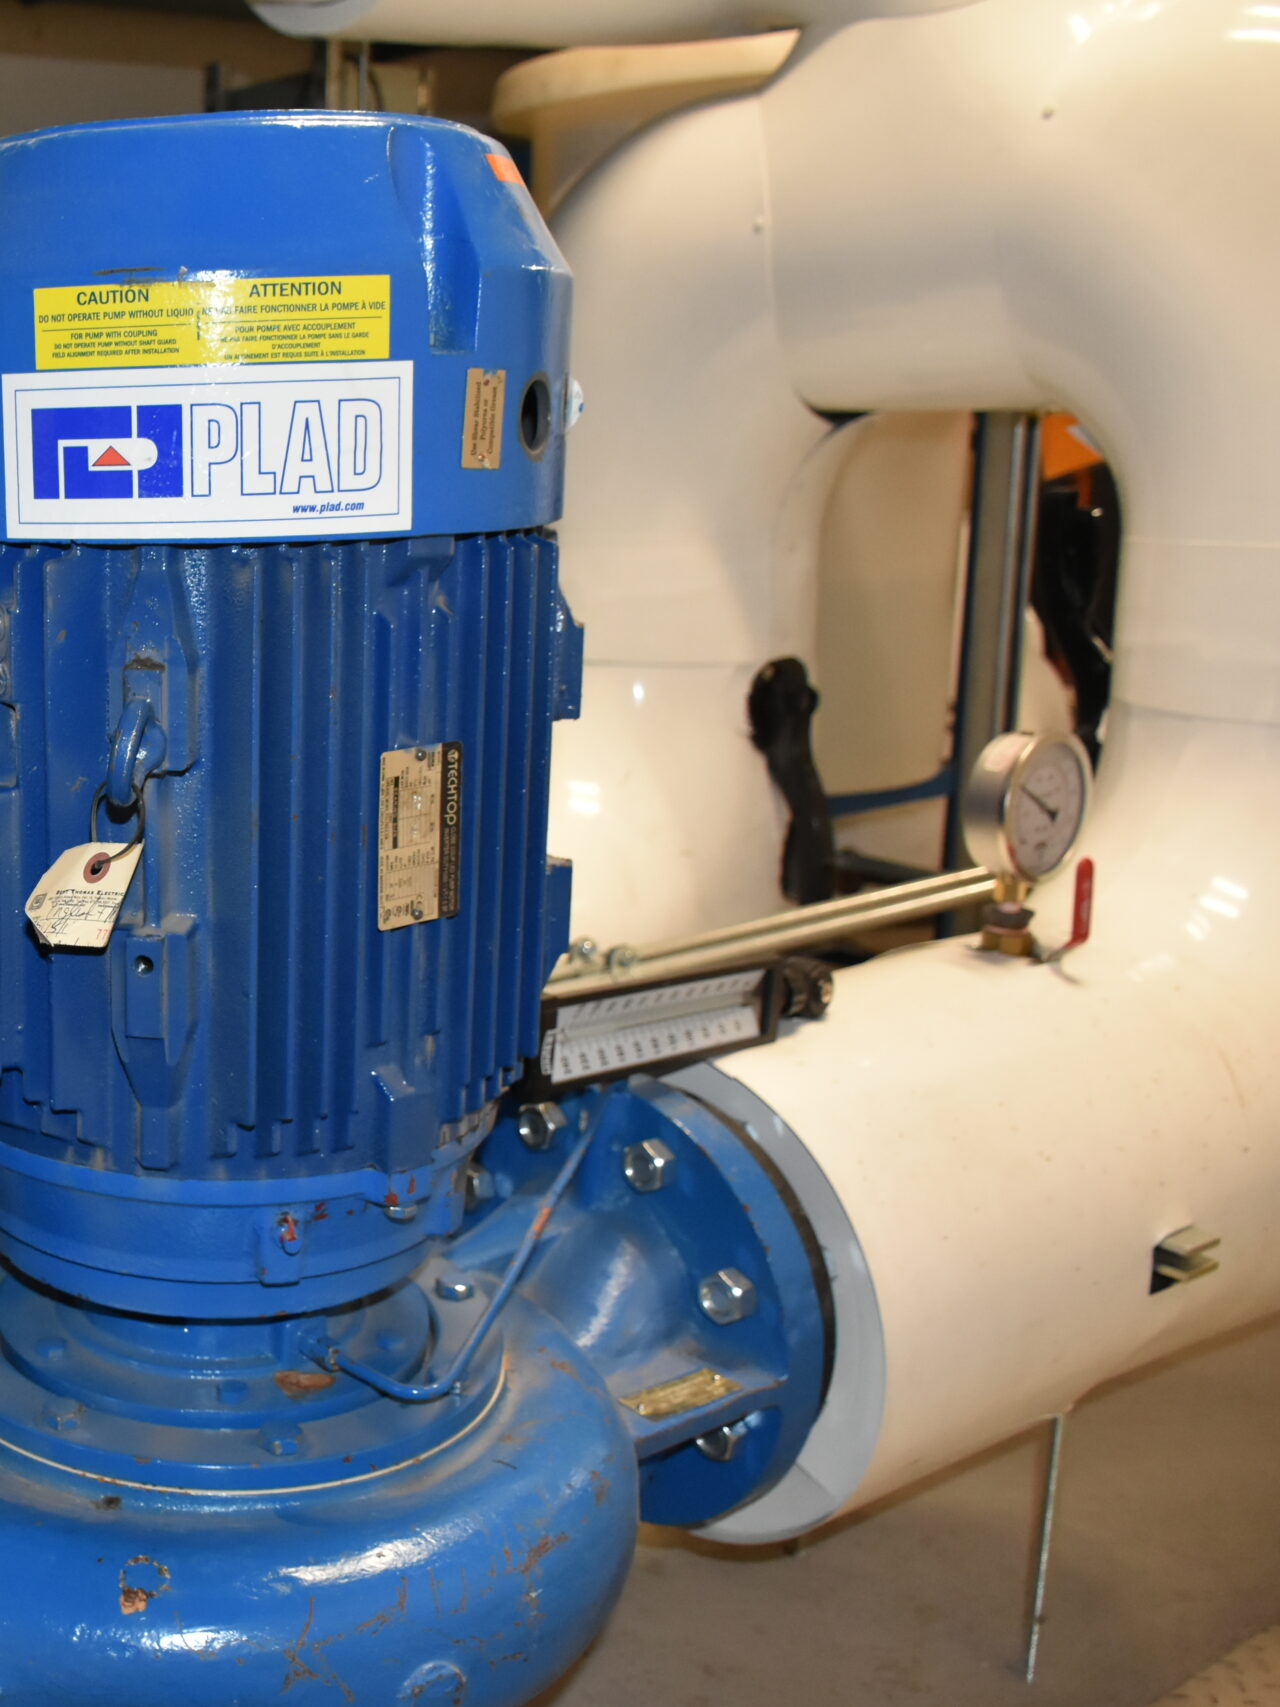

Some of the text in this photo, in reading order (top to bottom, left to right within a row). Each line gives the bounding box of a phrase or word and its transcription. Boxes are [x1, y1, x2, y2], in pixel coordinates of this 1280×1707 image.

[249, 281, 342, 298] ATTENTION
[77, 289, 149, 306] CAUTION
[235, 304, 257, 314] FAIRE
[260, 303, 317, 313] FONCTIONNER
[320, 303, 329, 311] LA
[332, 302, 359, 311] POMPE
[361, 300, 366, 310] À
[369, 301, 386, 310] VIDE
[39, 308, 193, 323] DO NOT OPERATE PUMP WITHOUT LIQUID
[71, 332, 83, 340] FOR
[85, 331, 103, 339] PUMP
[124, 329, 158, 338] COUPLING
[235, 322, 356, 333] POUR POMPE AVEC ACCOUPLEMENT
[259, 333, 298, 341] FONCTIONNER
[190, 398, 382, 497] PLAD
[292, 501, 365, 514] www.plad.com
[445, 763, 458, 824] TECHTOP
